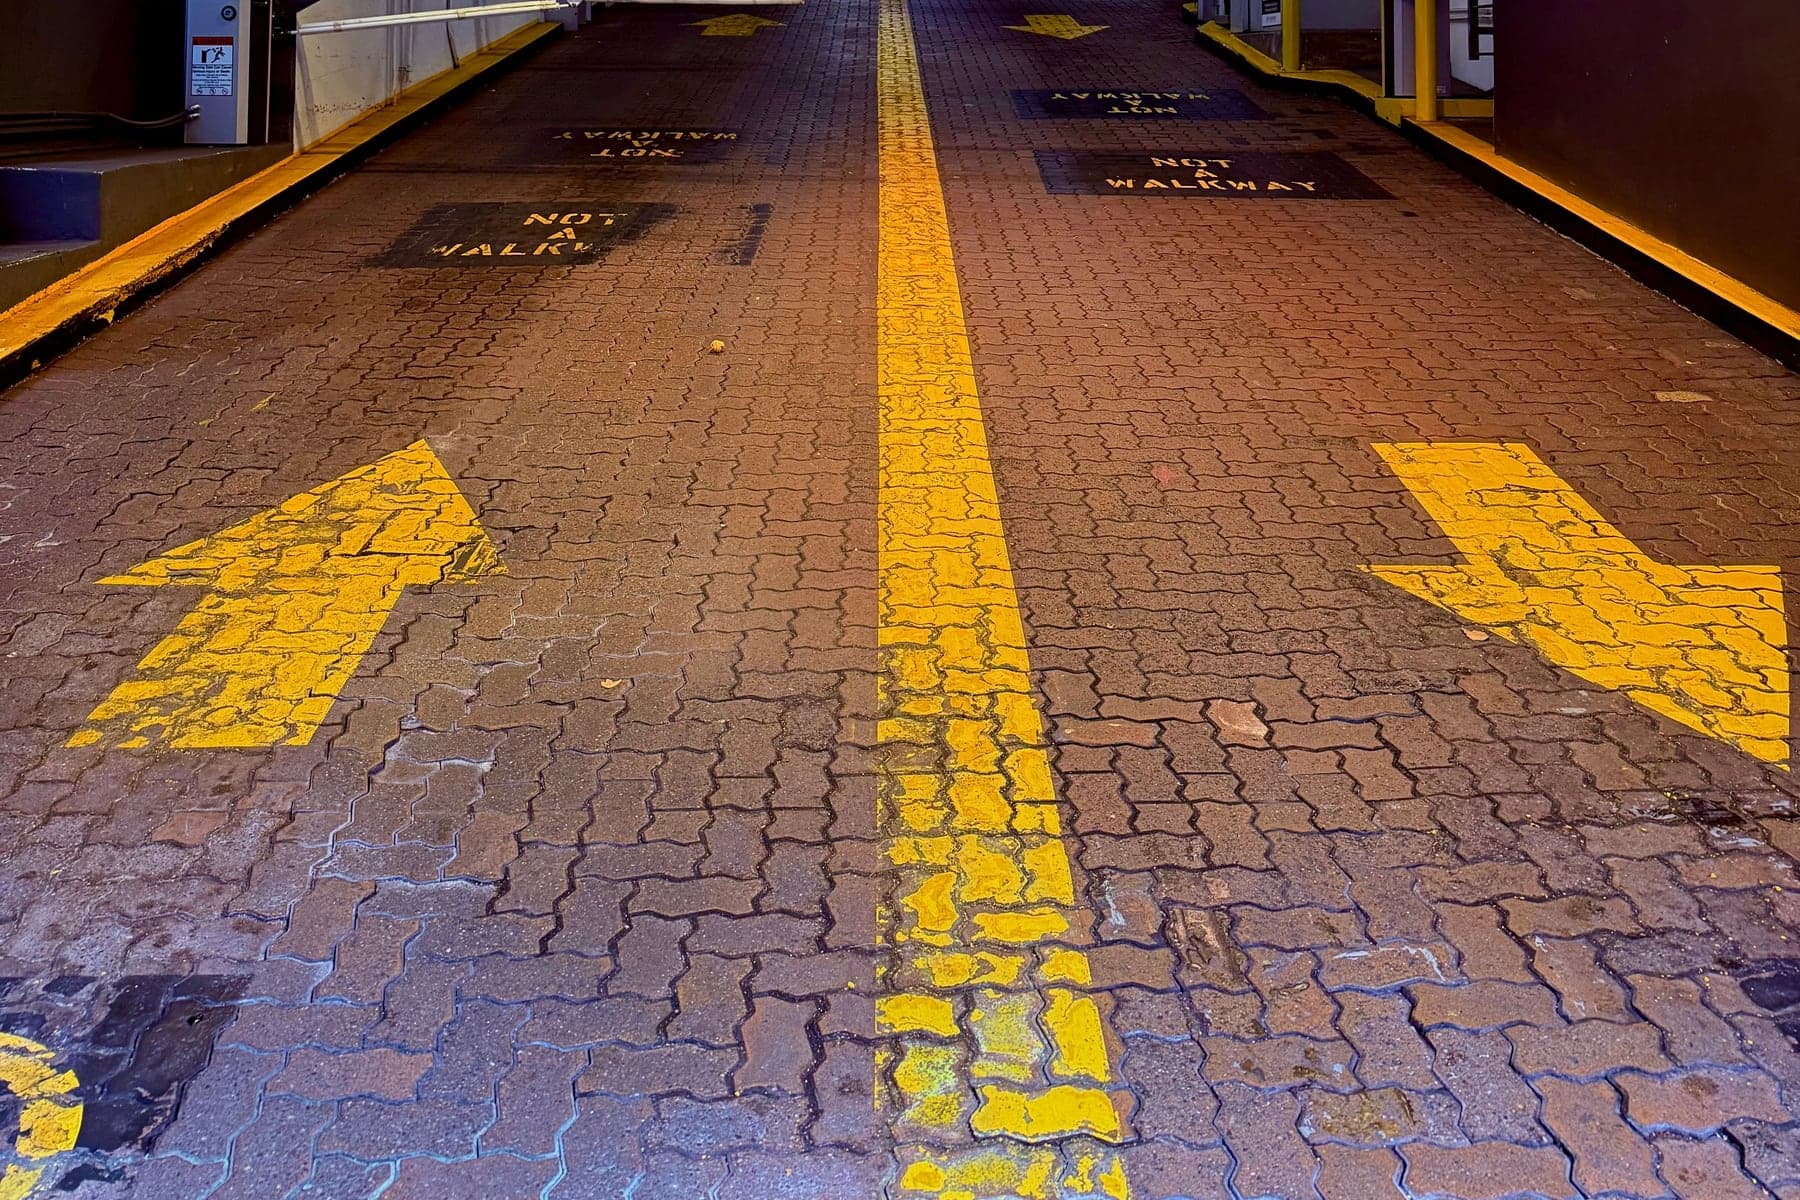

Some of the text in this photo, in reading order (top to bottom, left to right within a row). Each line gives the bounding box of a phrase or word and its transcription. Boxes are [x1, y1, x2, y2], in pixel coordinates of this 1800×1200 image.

[1151, 157, 1233, 168] NOT
[1194, 168, 1217, 178] A
[1105, 178, 1315, 191] WALKWAY
[523, 213, 628, 226] NOT
[547, 227, 577, 239] A
